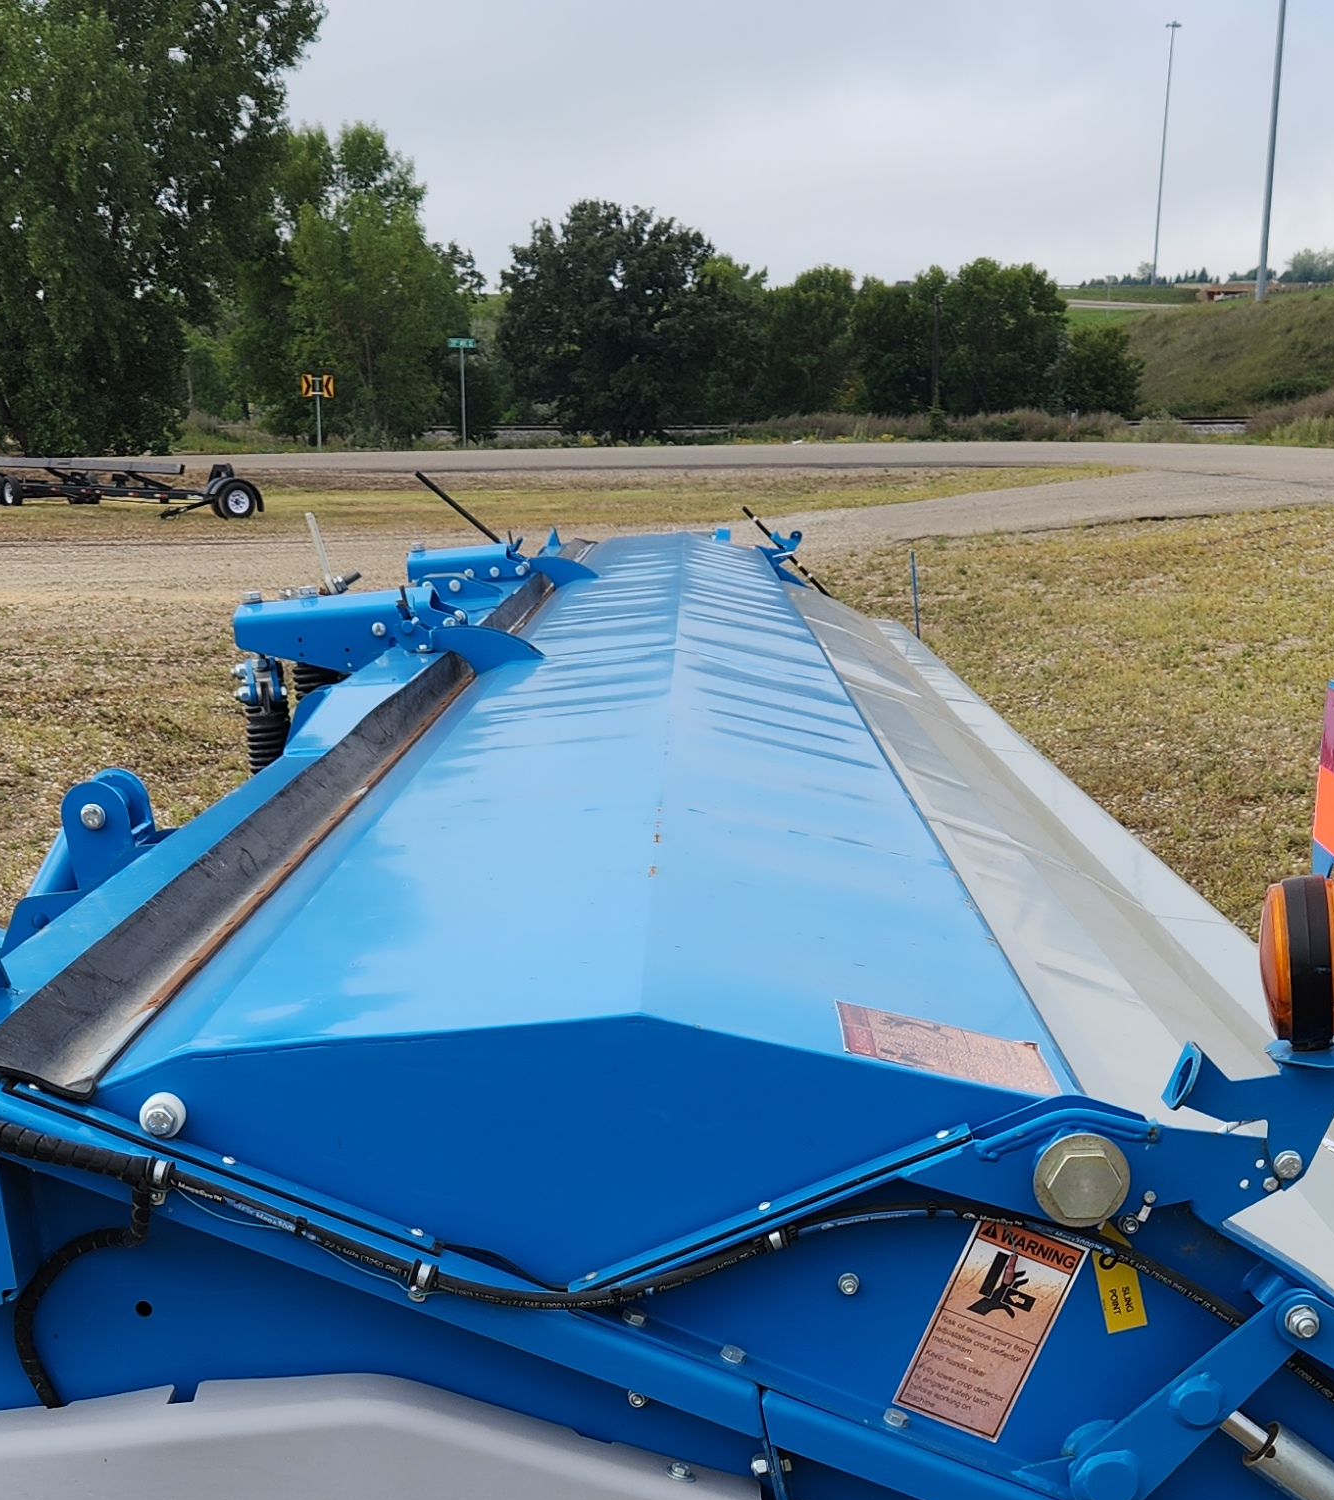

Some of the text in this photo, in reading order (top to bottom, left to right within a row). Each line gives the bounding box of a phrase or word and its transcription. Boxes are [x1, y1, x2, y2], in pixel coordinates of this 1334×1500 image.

[1001, 1228, 1076, 1269] WARNING
[1109, 1288, 1121, 1314] POINT
[1122, 1286, 1134, 1312] SLING
[931, 1334, 972, 1355] mechanism
[935, 1324, 1022, 1364] adjustable crop deflector
[940, 1314, 1030, 1356] Risk of serious injury from
[924, 1348, 987, 1378] Keep hands clear
[904, 1391, 938, 1409] machine
[908, 1381, 972, 1411] before working on
[920, 1375, 950, 1393] engage
[948, 1386, 973, 1401] safety
[971, 1394, 991, 1408] latch
[935, 1369, 957, 1383] lower
[955, 1379, 973, 1391] crop
[973, 1383, 1005, 1402] deflector
